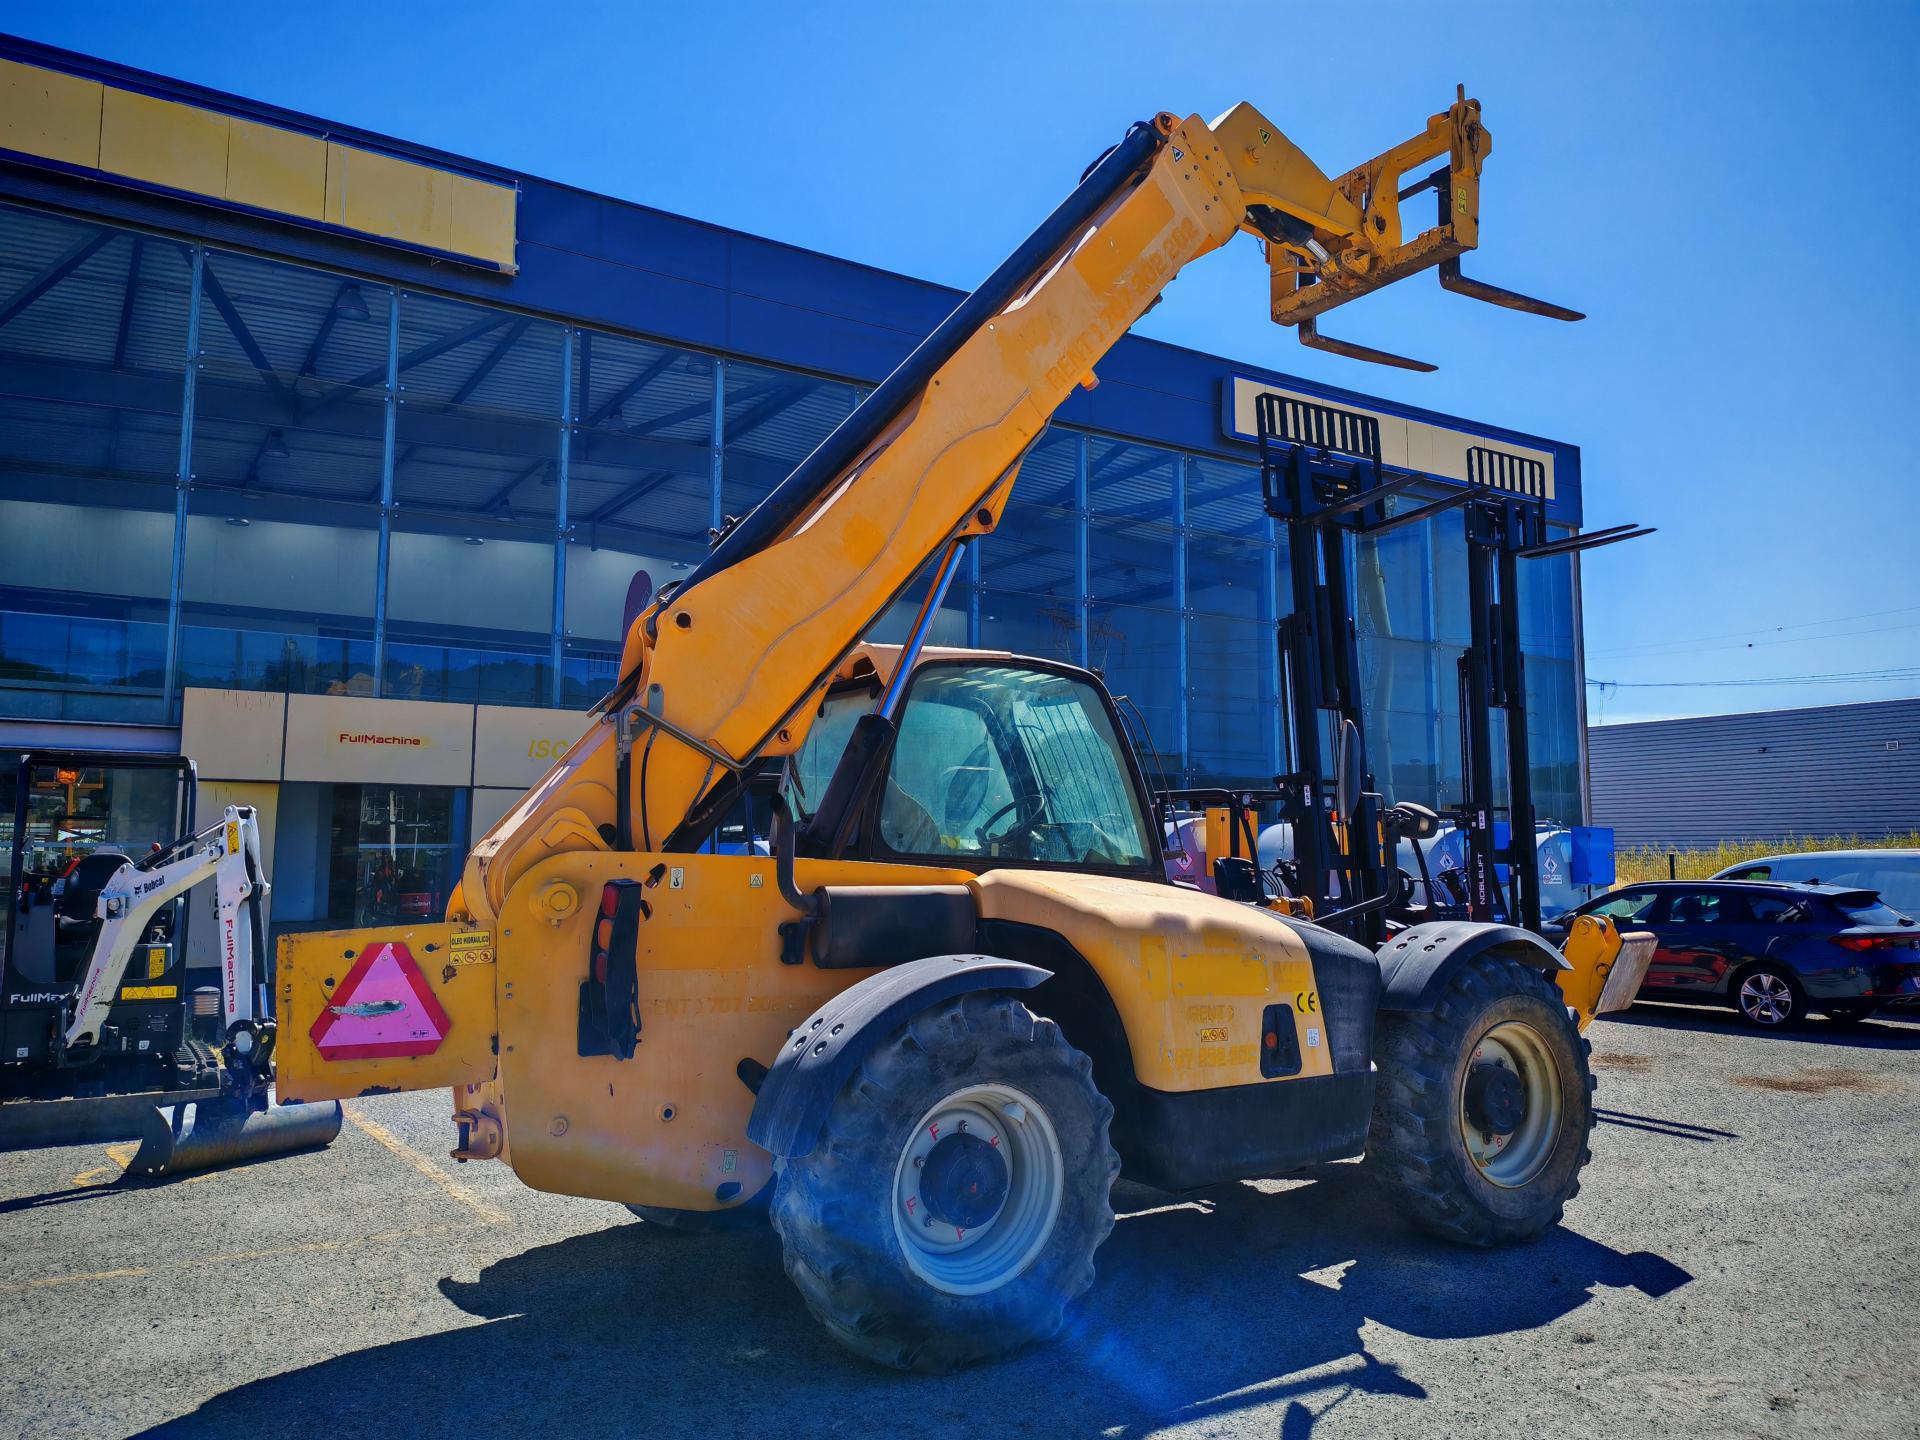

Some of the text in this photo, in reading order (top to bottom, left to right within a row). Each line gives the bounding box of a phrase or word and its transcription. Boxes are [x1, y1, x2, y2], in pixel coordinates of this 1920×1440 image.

[1045, 331, 1096, 392] RENT
[339, 733, 421, 746] FullMachine
[143, 875, 165, 893] Bobcat
[1477, 852, 1486, 905] NOBLELIFT
[225, 919, 236, 1013] FullMachine
[1296, 991, 1316, 1013] CE
